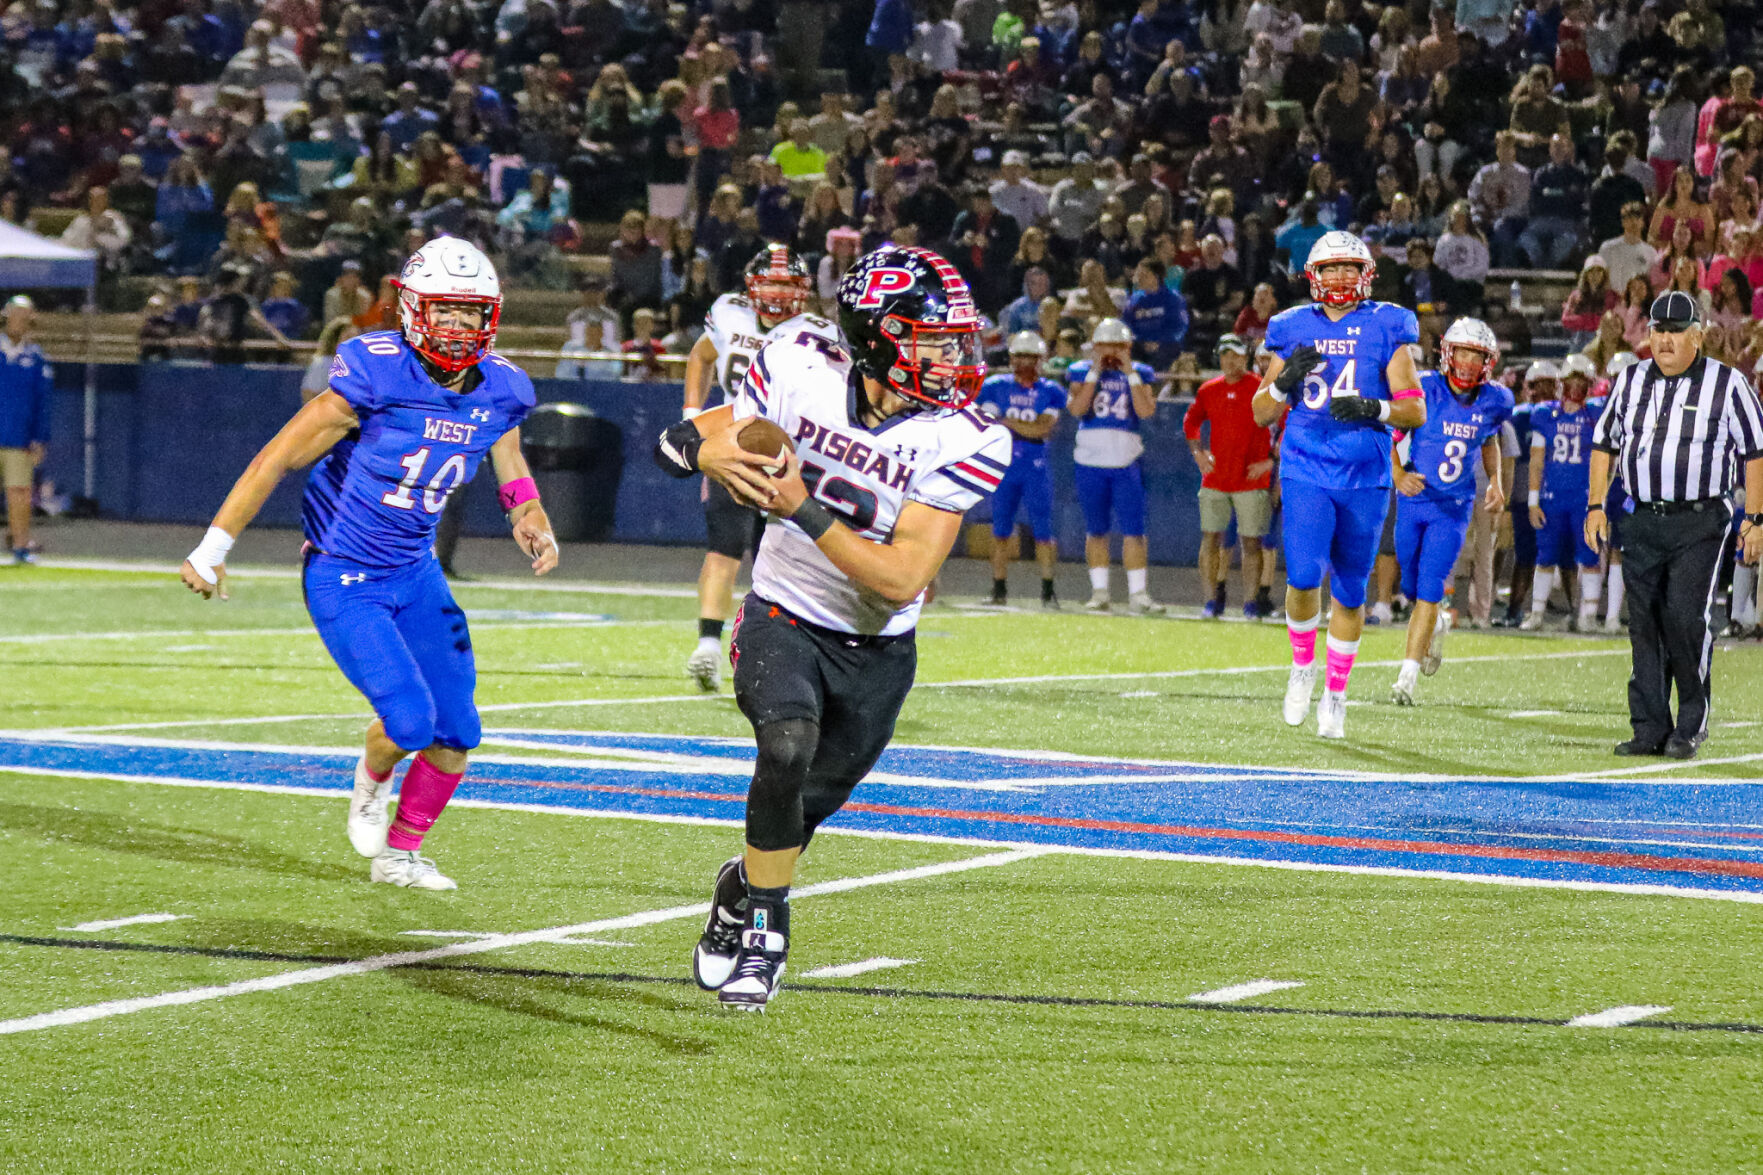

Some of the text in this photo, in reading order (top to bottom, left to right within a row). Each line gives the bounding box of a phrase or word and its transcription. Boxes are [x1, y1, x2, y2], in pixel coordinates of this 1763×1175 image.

[855, 266, 916, 309] P
[1314, 339, 1357, 355] WEST
[423, 417, 477, 445] WEST
[1443, 420, 1479, 439] WEST
[793, 416, 915, 492] PISGAH
[1438, 440, 1468, 483] 3
[382, 446, 466, 515] 10
